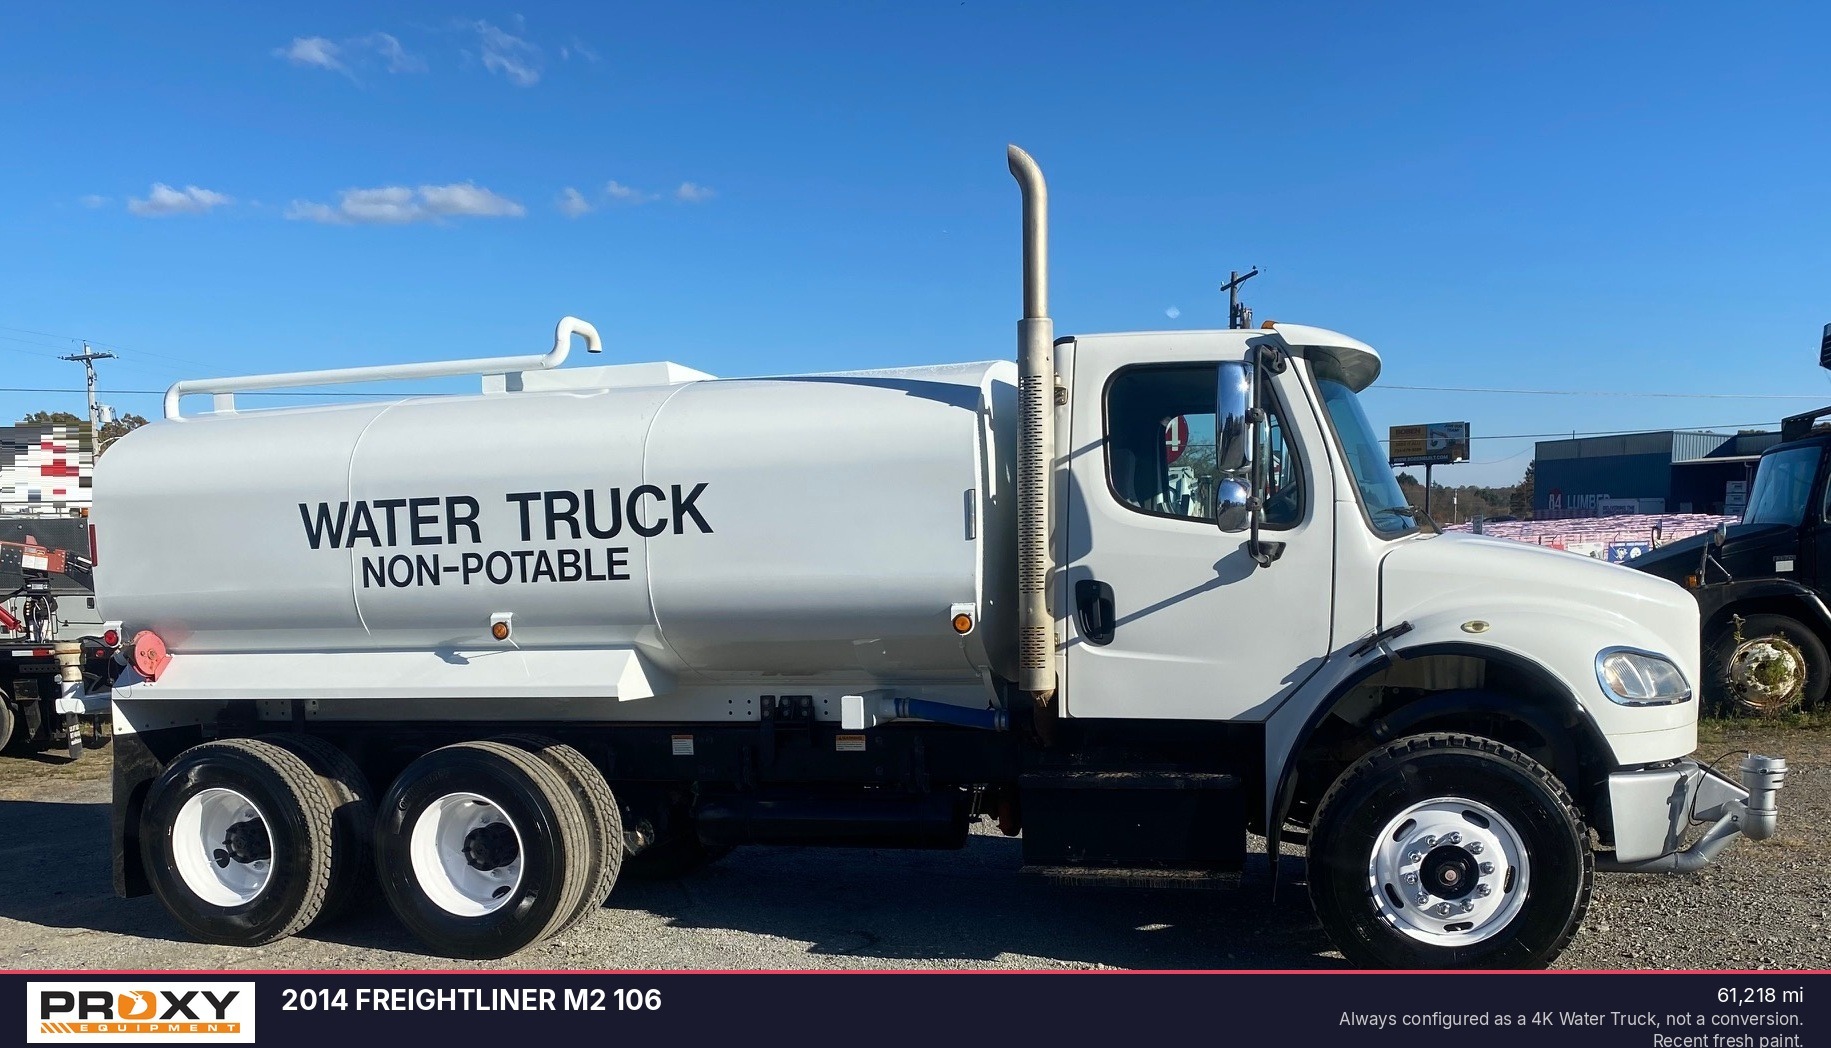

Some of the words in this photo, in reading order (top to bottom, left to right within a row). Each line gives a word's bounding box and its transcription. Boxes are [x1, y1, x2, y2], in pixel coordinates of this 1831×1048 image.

[298, 495, 481, 549] WATER
[506, 483, 714, 541] TRUCK
[1549, 493, 1562, 509] 84
[362, 547, 630, 588] NON-POTABLE
